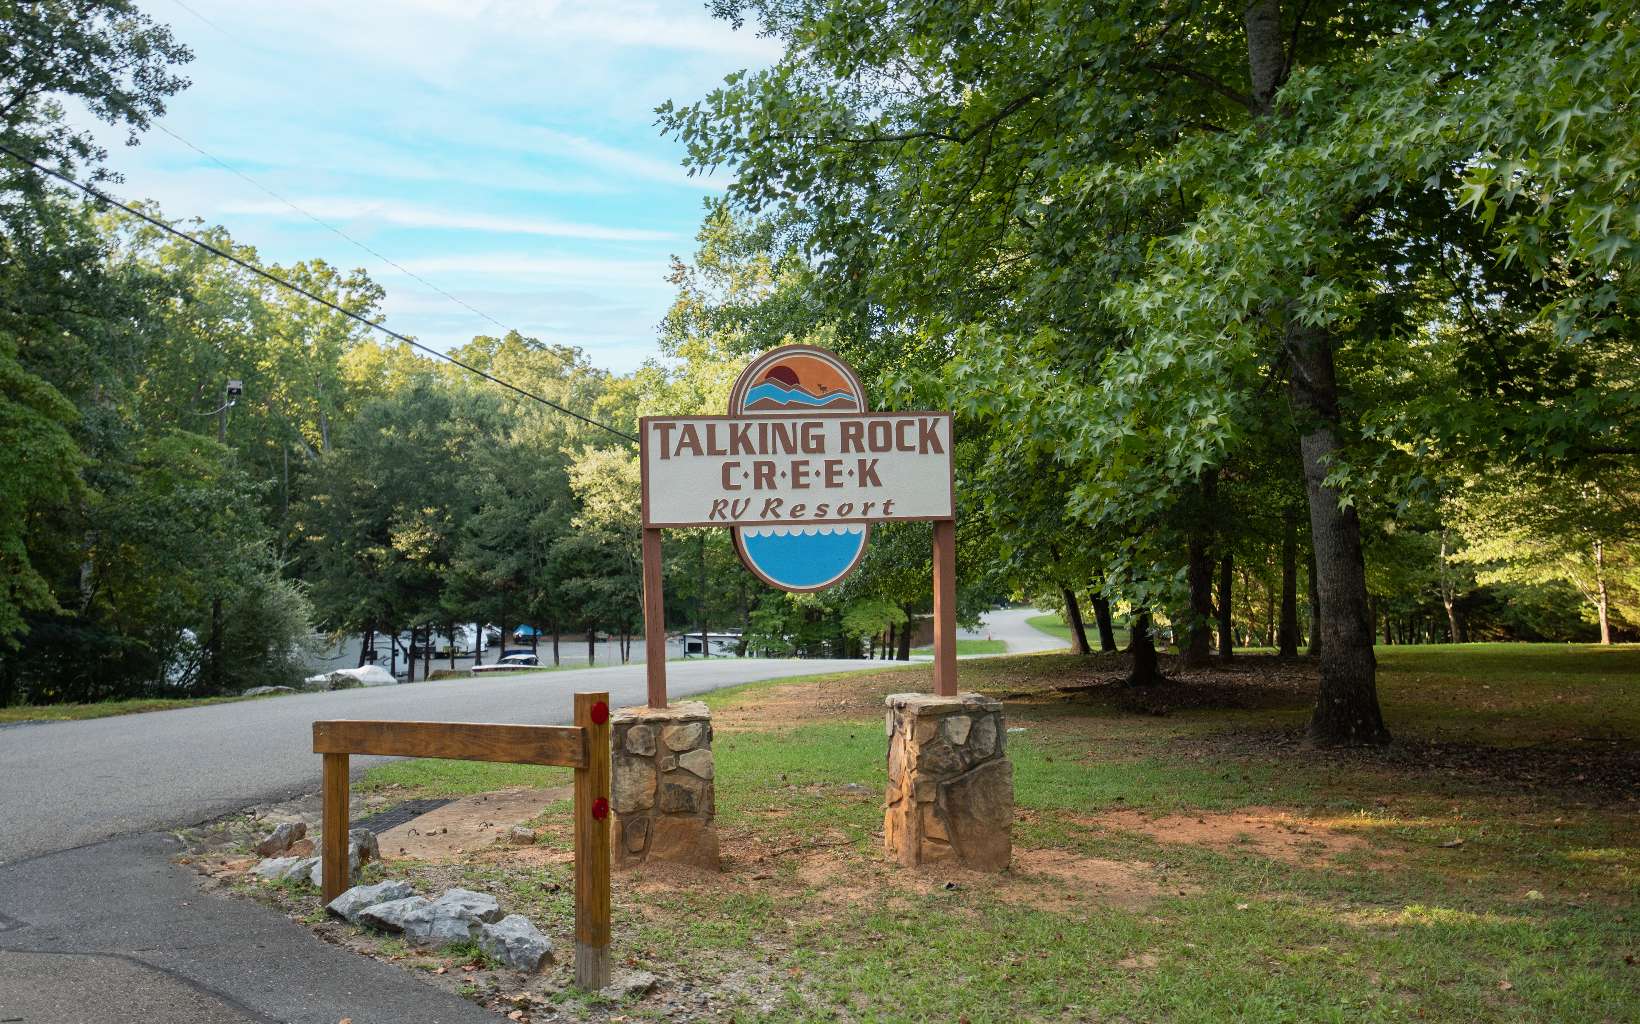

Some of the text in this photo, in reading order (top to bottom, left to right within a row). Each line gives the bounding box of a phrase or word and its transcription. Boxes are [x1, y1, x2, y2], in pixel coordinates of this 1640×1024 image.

[653, 418, 945, 460] TALKING ROCK
[709, 498, 896, 521] RV Resort
